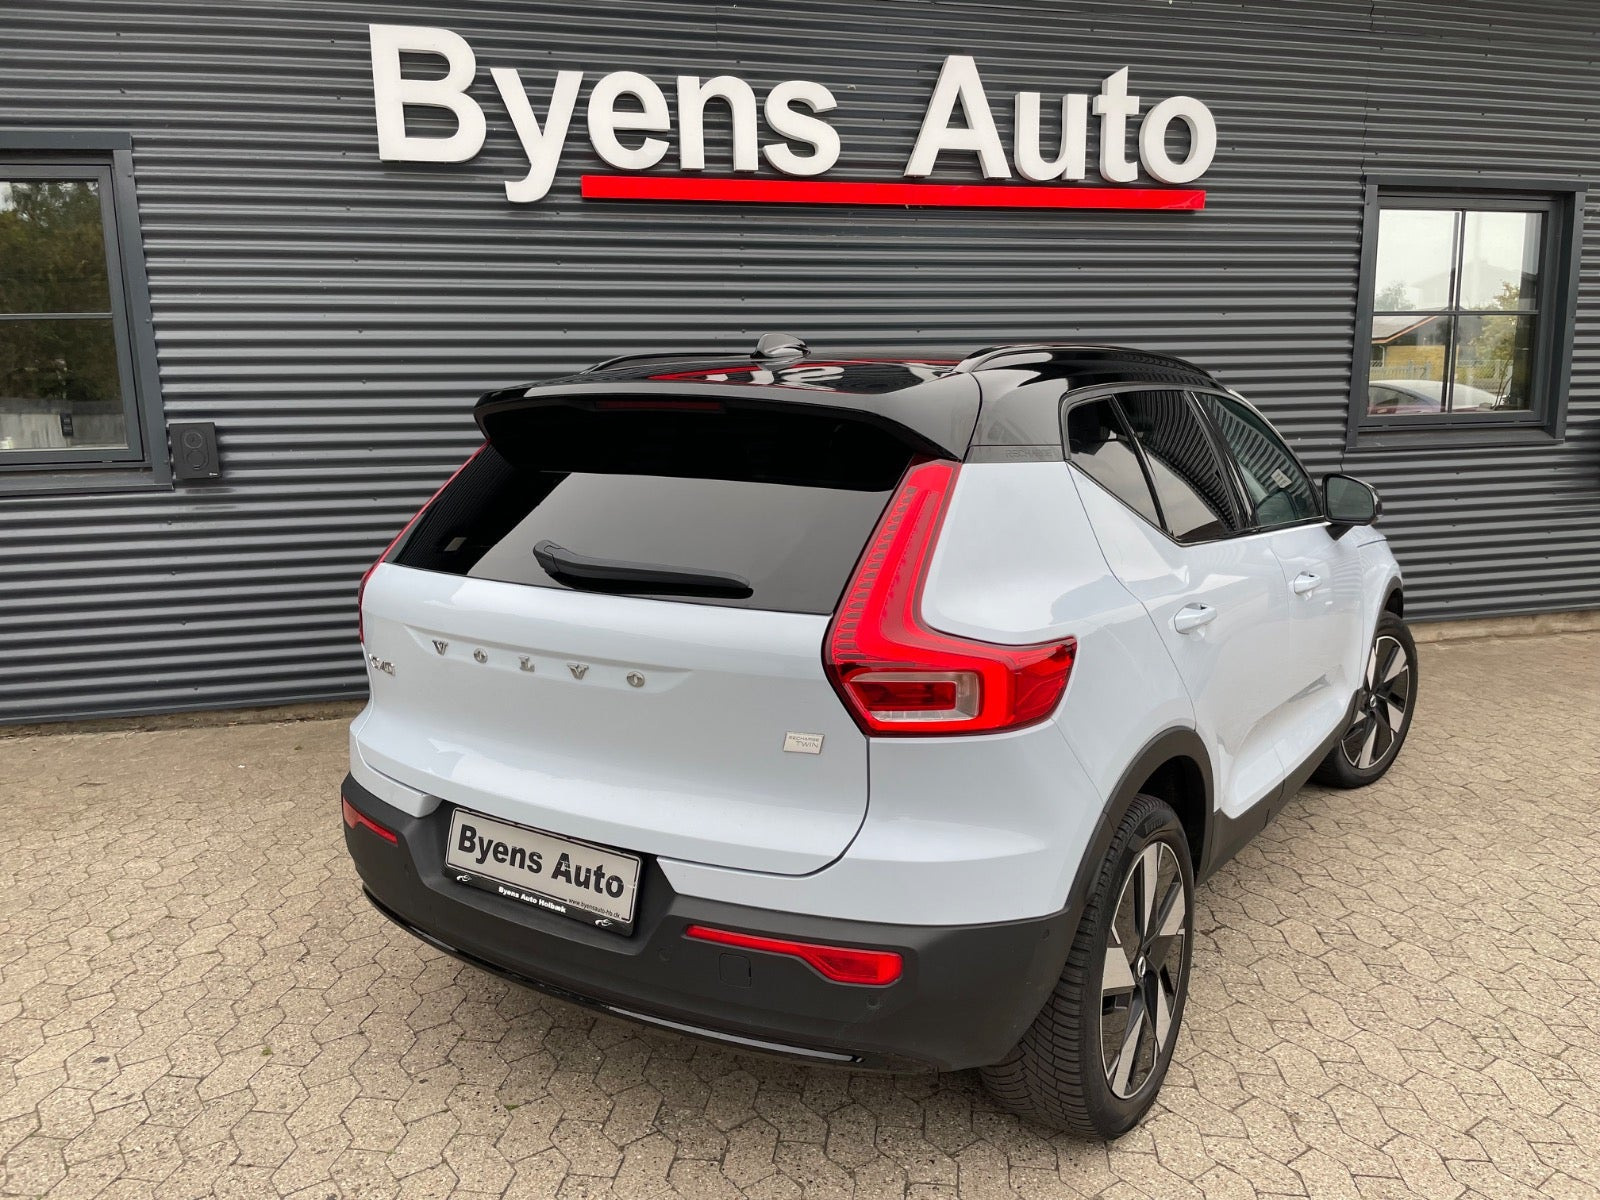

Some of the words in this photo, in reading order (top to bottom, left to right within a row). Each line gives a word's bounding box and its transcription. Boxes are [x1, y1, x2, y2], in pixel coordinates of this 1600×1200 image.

[369, 24, 841, 203] Byens
[903, 54, 1218, 185] Auto
[432, 639, 646, 688] VOLVO
[458, 823, 543, 874] Byens
[551, 852, 624, 898] Auto
[498, 885, 520, 898] Byens
[520, 893, 538, 904] Auto
